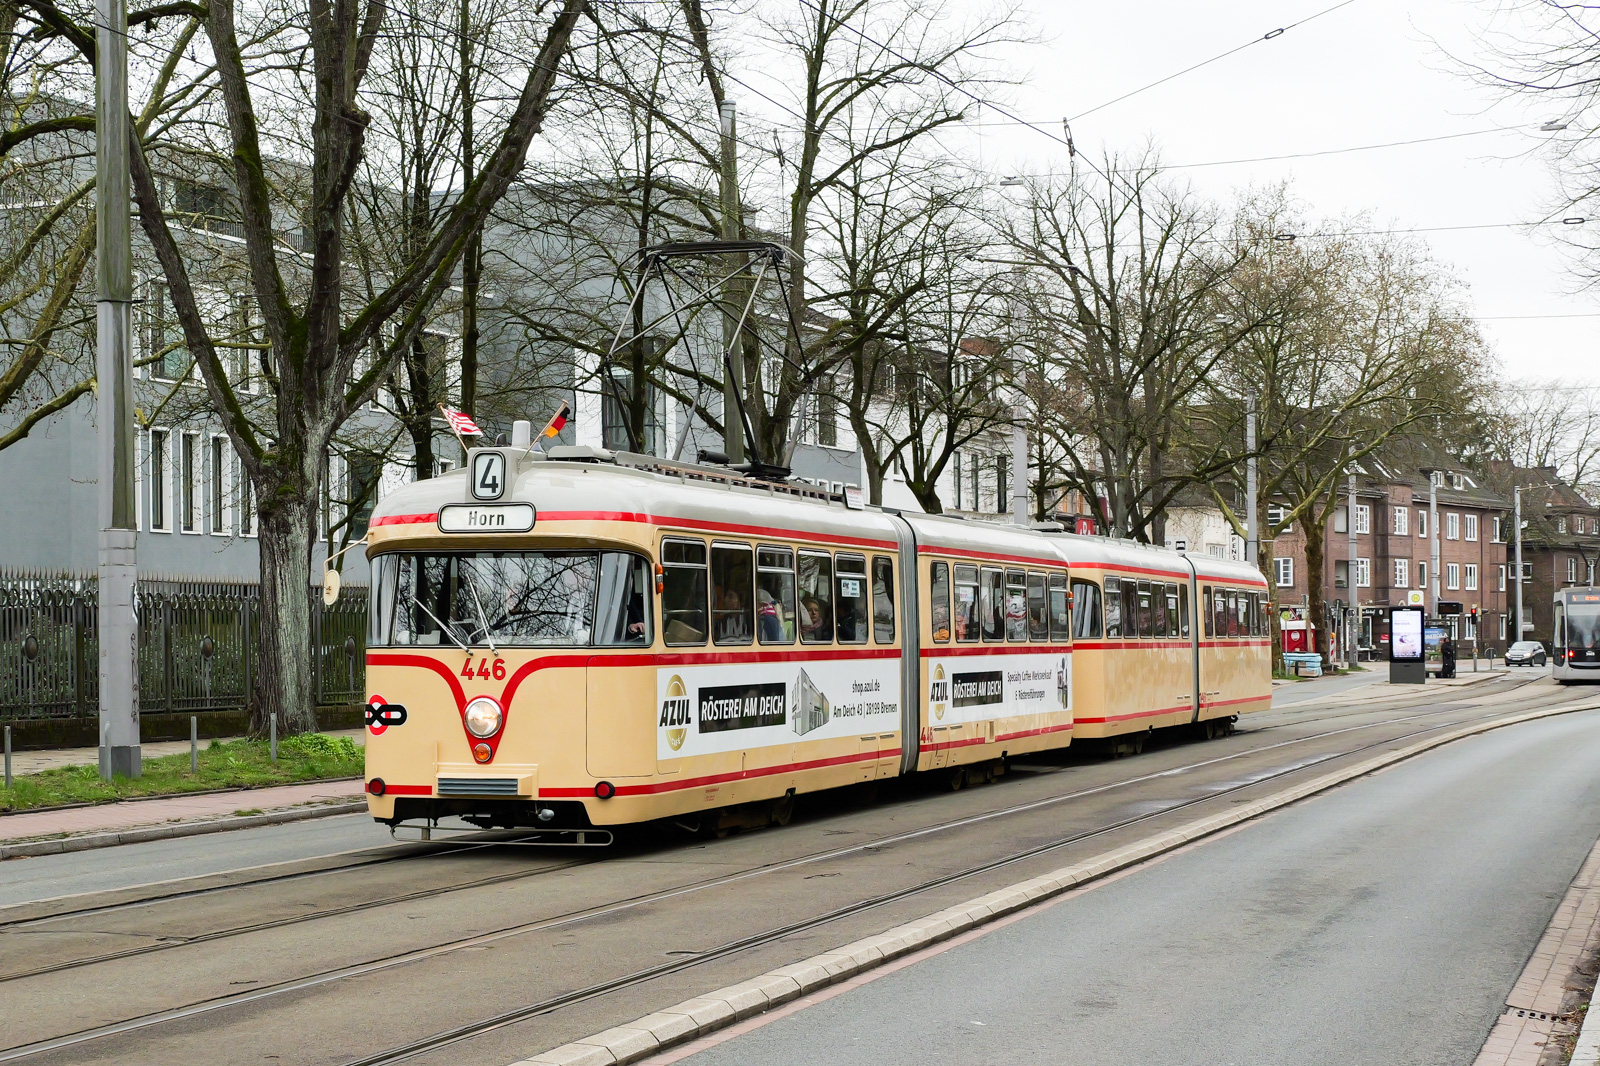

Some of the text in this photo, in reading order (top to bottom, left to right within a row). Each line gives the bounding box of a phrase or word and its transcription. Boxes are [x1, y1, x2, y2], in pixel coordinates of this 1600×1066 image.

[480, 457, 499, 494] 4
[468, 510, 505, 526] Horn
[461, 658, 506, 681] 446
[852, 678, 880, 696] shop.azul.de
[930, 681, 948, 702] AZUL
[953, 679, 1001, 699] RÖSTEREI AM DEICH
[659, 698, 692, 727] AZUL
[701, 694, 784, 722] RÖSTEREI AM DEICH
[833, 701, 897, 718] Am Deich 43 28199 Bremen
